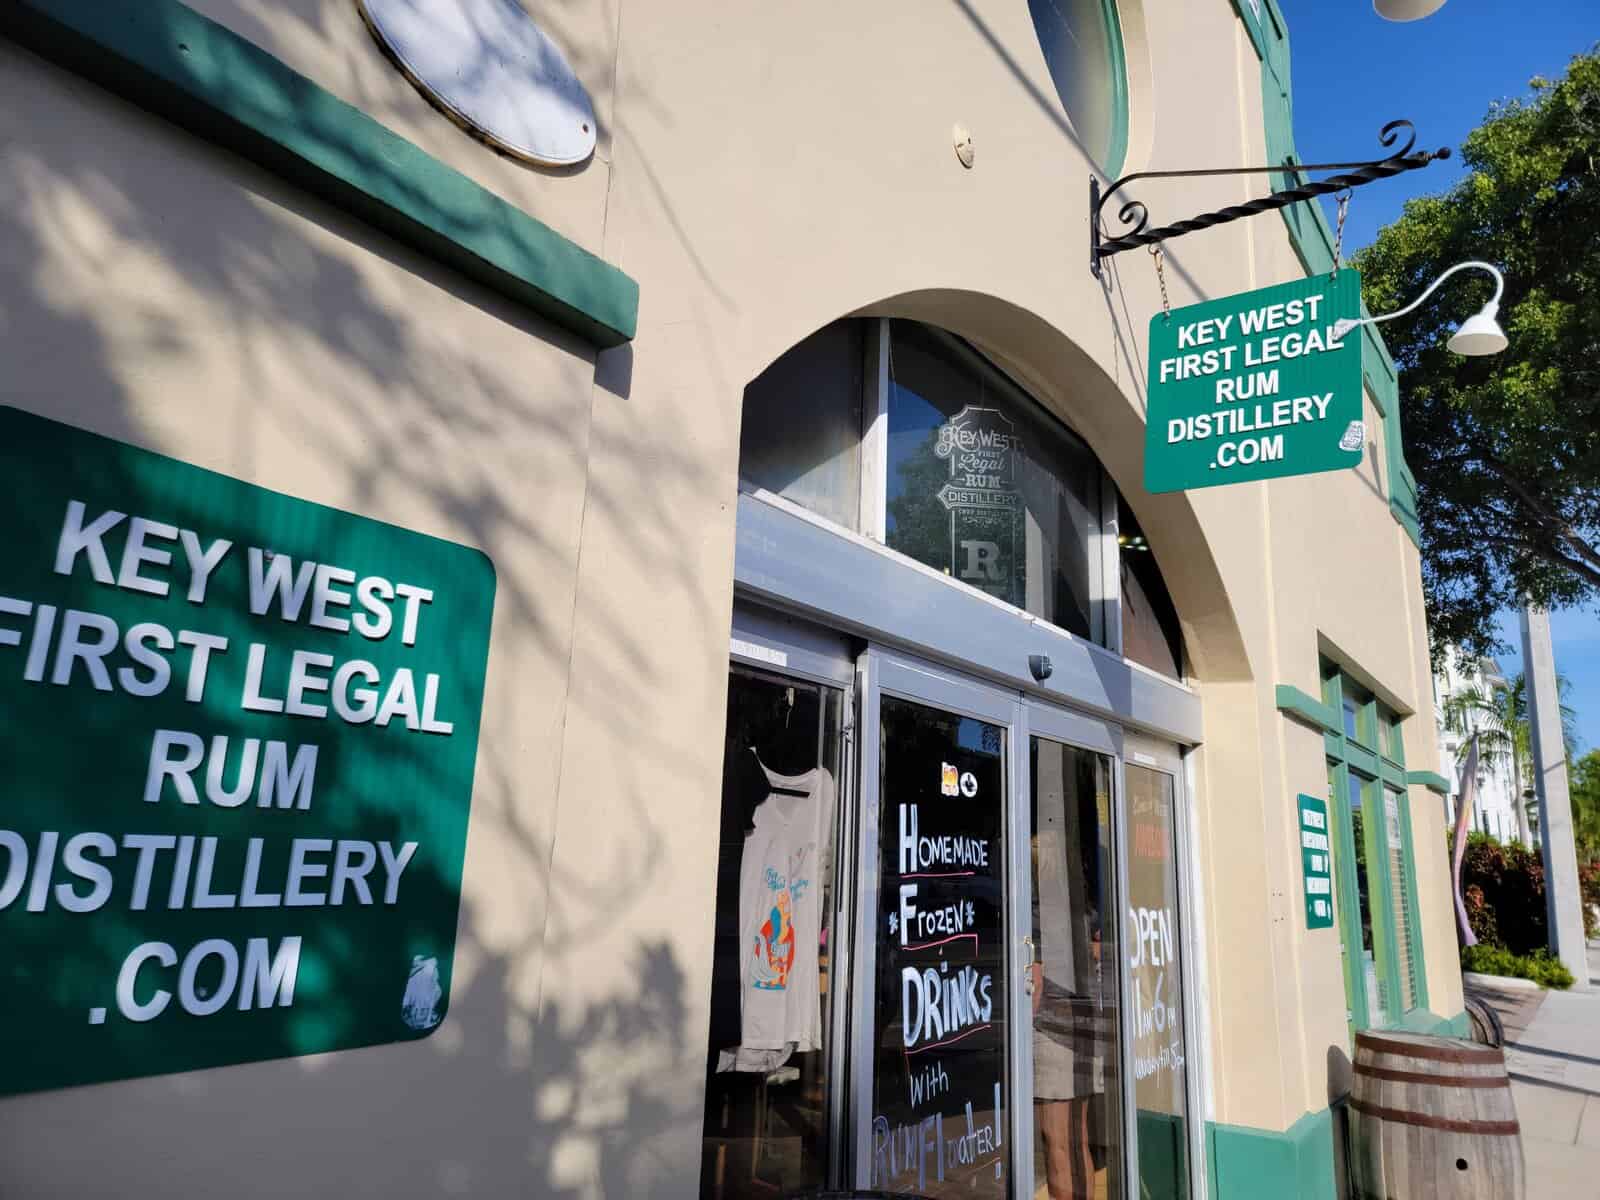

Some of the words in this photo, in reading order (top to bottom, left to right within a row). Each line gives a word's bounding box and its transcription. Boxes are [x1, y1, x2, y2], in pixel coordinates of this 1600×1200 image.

[1178, 316, 1233, 349] KEY
[1239, 295, 1323, 336] WEST
[1160, 346, 1238, 383] FIRST
[1245, 326, 1345, 366] LEGAL
[1215, 370, 1279, 404] RUM
[934, 421, 979, 458] KEY
[1167, 393, 1333, 444] DISTILLERY
[1209, 435, 1284, 469] .COM
[948, 491, 1017, 505] DISTILLERY
[965, 474, 1001, 489] RUM
[53, 500, 232, 602] KEY
[248, 546, 433, 647] WEST
[241, 643, 454, 734] LEGAL
[143, 728, 318, 810] RUM
[899, 803, 989, 875] HOMEMADE
[88, 936, 302, 1024] .COM
[910, 1060, 950, 1109] with
